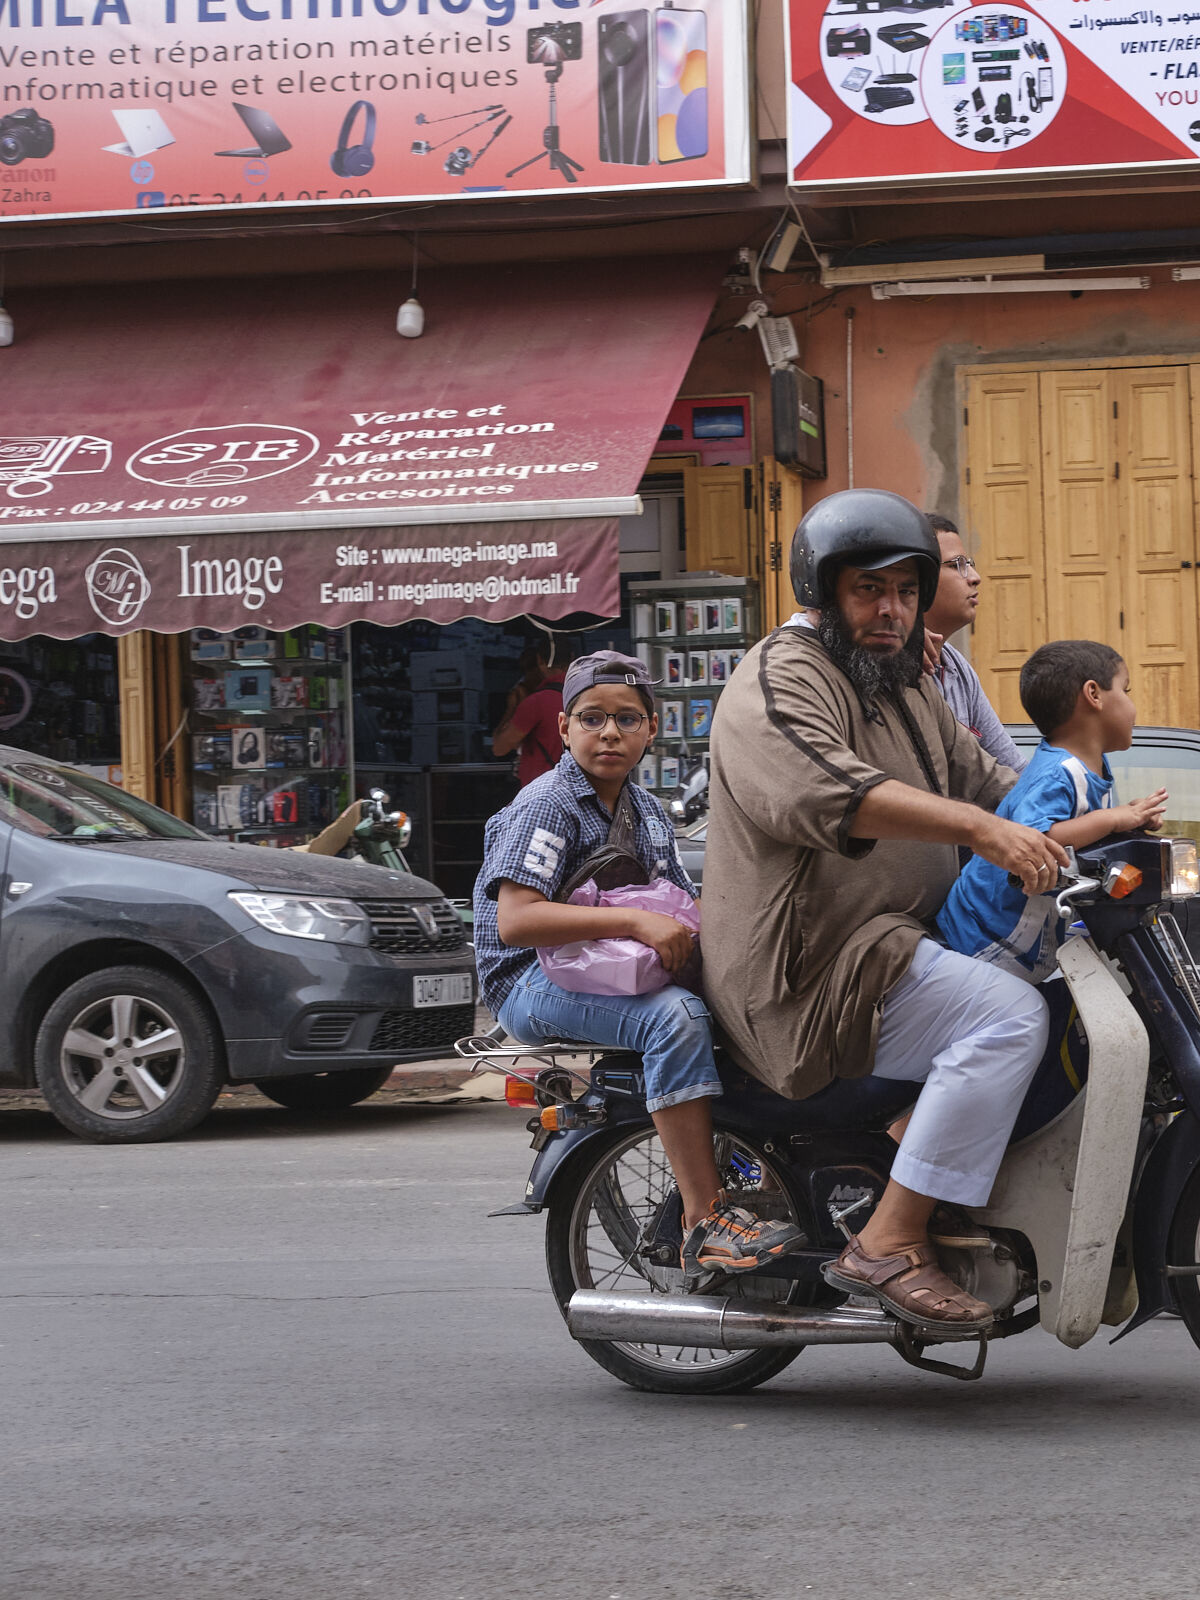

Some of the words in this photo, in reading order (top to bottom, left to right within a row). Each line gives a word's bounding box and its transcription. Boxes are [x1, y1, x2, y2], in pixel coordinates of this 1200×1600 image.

[0, 44, 96, 67] Vente
[108, 43, 142, 65] et
[155, 38, 335, 68] réparation
[350, 29, 511, 58] matériels
[231, 74, 264, 95] et
[277, 67, 519, 94] electroniques
[0, 168, 56, 184] anon
[1, 188, 52, 203] Zahra
[350, 407, 459, 427] Vente
[466, 404, 507, 419] et
[335, 421, 556, 447] Réparation
[320, 442, 496, 468] Matériel
[309, 461, 600, 488] Informatiques
[296, 483, 516, 504] Accesoires
[336, 546, 369, 567] Site
[382, 541, 558, 567] www.mega-image.ma
[176, 545, 284, 610] Image
[320, 581, 374, 604] E-mail
[388, 573, 580, 605] megaimage@hotmail.fr
[524, 827, 565, 879] 5
